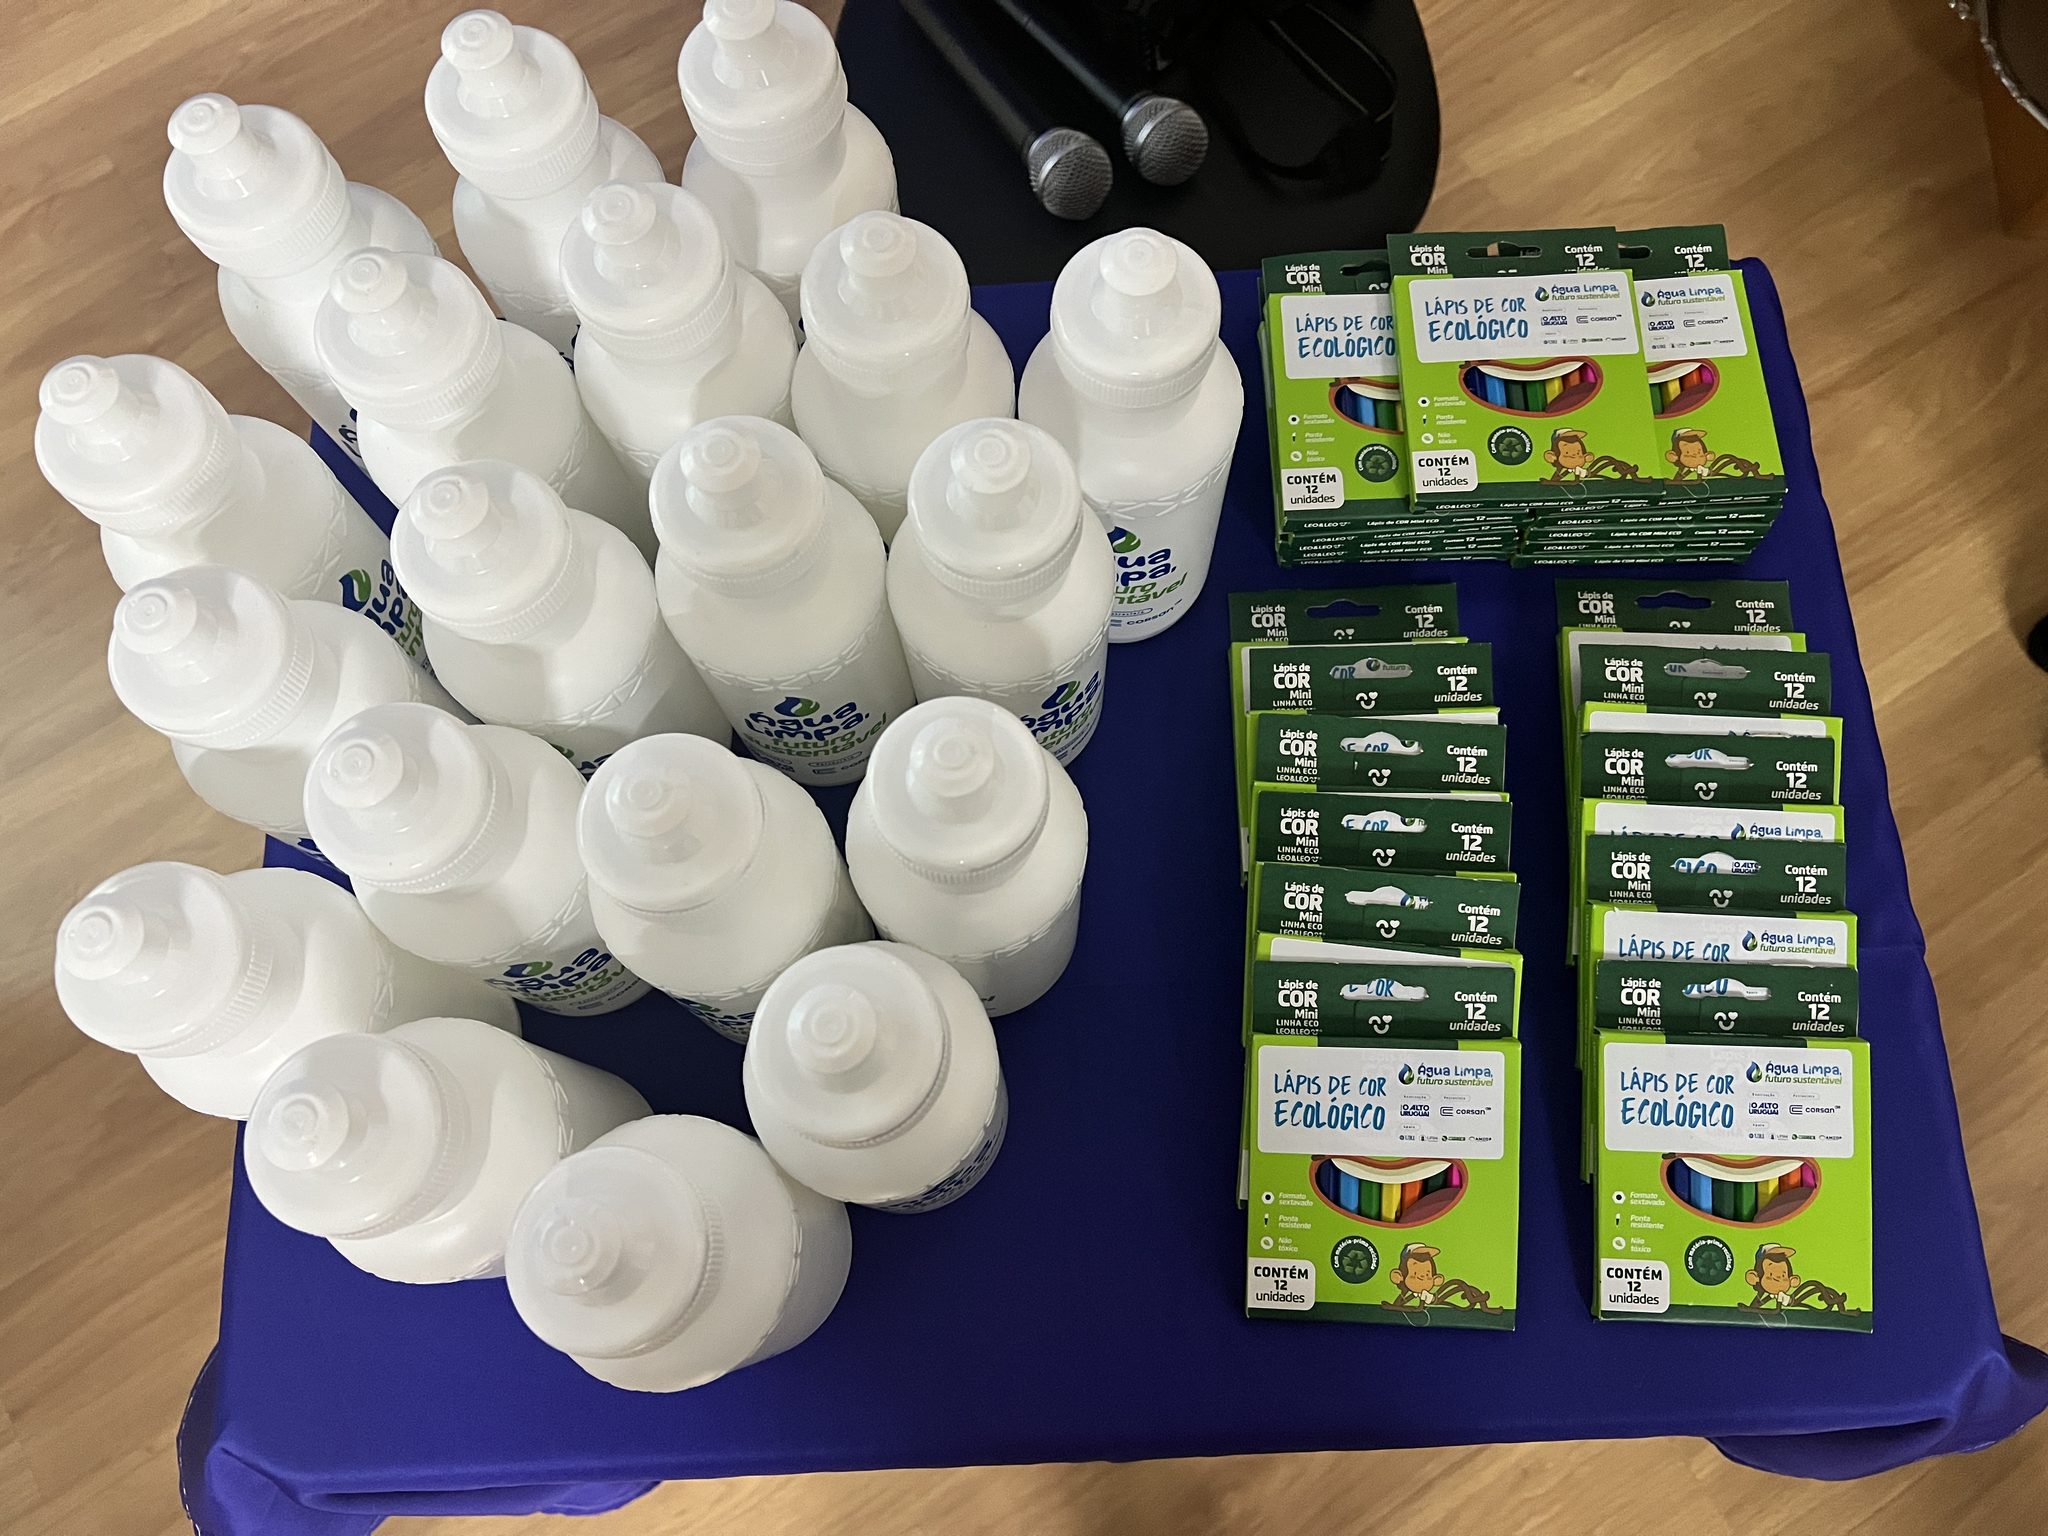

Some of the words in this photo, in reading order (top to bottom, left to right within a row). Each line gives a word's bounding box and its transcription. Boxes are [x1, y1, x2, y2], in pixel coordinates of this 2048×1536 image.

[1409, 245, 1432, 254] Lápis
[1434, 244, 1445, 252] de
[1564, 244, 1603, 254] Contém
[1674, 244, 1712, 255] Contém
[1411, 252, 1446, 267] COR
[1575, 254, 1595, 266] 12
[1685, 255, 1704, 268] 12
[1285, 264, 1307, 273] Lápis
[1427, 266, 1448, 274] Mini
[1286, 272, 1321, 285] COR
[1302, 285, 1322, 293] Mini
[1551, 284, 1580, 295] Água
[1425, 297, 1468, 317] LÁPIS
[1474, 298, 1493, 313] DE
[1501, 297, 1527, 313] COR
[1296, 313, 1338, 333] LÁPIS
[1343, 315, 1363, 332] DE
[1370, 315, 1394, 331] COR
[1428, 315, 1529, 342] ECOLÓGICO
[1298, 332, 1396, 359] ECOLÓGICO
[1418, 455, 1469, 468] CONTÉM
[1438, 467, 1451, 476] 12
[1286, 473, 1337, 485] CONTÉM
[1422, 477, 1469, 487] unidades
[1305, 485, 1319, 494] 12
[1290, 494, 1336, 505] unidades
[1117, 548, 1171, 568] ua
[1578, 592, 1600, 601] Lápis
[1602, 592, 1613, 600] de
[1251, 605, 1273, 614] Lápis
[1274, 604, 1286, 612] de
[1405, 605, 1442, 614] Contém
[1578, 600, 1614, 614] COR
[1735, 600, 1774, 609] Contém
[1251, 614, 1286, 628] COR
[1415, 615, 1435, 628] 12
[1595, 615, 1616, 624] Mini
[1746, 609, 1766, 623] 12
[1267, 628, 1287, 637] Mini
[1403, 628, 1448, 639] unidades
[1734, 623, 1781, 633] unidades
[1273, 663, 1297, 673] Lápis
[1299, 663, 1310, 672] de
[1604, 658, 1629, 667] Lápis
[1630, 659, 1643, 667] de
[1437, 665, 1477, 676] Contém
[1605, 667, 1643, 683] COR
[1273, 672, 1311, 689] COR
[1774, 671, 1816, 683] Contém
[1447, 676, 1468, 691] 12
[1621, 683, 1644, 693] Mini
[1290, 690, 1311, 700] Mini
[1434, 692, 1482, 702] unidades
[1784, 683, 1805, 699] 12
[1769, 699, 1819, 710] unidades
[749, 702, 857, 731] Água
[772, 731, 856, 749] futuro
[1280, 729, 1304, 739] Lápis
[1305, 730, 1318, 739] de
[1279, 740, 1317, 757] COR
[1447, 745, 1488, 756] Contém
[1294, 757, 1317, 767] Mini
[1456, 757, 1477, 773] 12
[1277, 766, 1301, 774] LINHA
[1303, 767, 1318, 775] ECO
[1441, 773, 1491, 785] unidades
[1750, 822, 1781, 838] Água
[1611, 852, 1636, 862] Lápis
[1638, 852, 1651, 861] de
[1611, 862, 1650, 880] COR
[1785, 864, 1828, 876] Contém
[1628, 880, 1651, 891] Mini
[1795, 876, 1817, 893] 12
[1610, 890, 1634, 898] LINHA
[1636, 891, 1652, 899] ECO
[1780, 893, 1832, 905] unidades
[1760, 930, 1792, 945] Água
[1619, 934, 1666, 959] LÁPIS
[1672, 941, 1695, 960] DE
[1702, 943, 1730, 962] COR
[1760, 944, 1786, 953] futuro
[1787, 945, 1836, 955] sustentável
[1278, 979, 1304, 991] Lápis
[1306, 980, 1319, 990] de
[1621, 977, 1648, 989] Lápis
[1650, 978, 1661, 988] de
[1278, 990, 1318, 1008] COR
[1454, 991, 1498, 1003] Contém
[1621, 988, 1660, 1006] COR
[1797, 991, 1842, 1003] Contém
[1295, 1009, 1318, 1020] Mini
[1464, 1003, 1486, 1020] 12
[1637, 1007, 1660, 1017] Mini
[1809, 1004, 1830, 1020] 12
[1449, 1021, 1501, 1032] unidades
[1618, 1017, 1643, 1025] LINHA
[1646, 1018, 1661, 1026] ECO
[1792, 1021, 1845, 1033] unidades
[1417, 1063, 1450, 1078] Água
[1765, 1061, 1798, 1076] Água
[1274, 1069, 1321, 1095] LÁPIS
[1328, 1075, 1351, 1095] DE
[1359, 1076, 1387, 1097] COR
[1417, 1077, 1442, 1086] futuro
[1443, 1078, 1494, 1087] sustentável
[1620, 1067, 1669, 1093] LÁPIS
[1675, 1073, 1698, 1093] DE
[1706, 1074, 1734, 1095] COR
[1765, 1075, 1791, 1084] futuro
[1793, 1076, 1842, 1085] sustentável
[1274, 1097, 1386, 1131] ECOLÓGICO
[1621, 1095, 1734, 1129] ECOLÓGICO
[1254, 1265, 1309, 1279] CONTÉM
[1606, 1266, 1662, 1281] CONTÉM
[1274, 1280, 1288, 1291] 12
[1627, 1281, 1642, 1292] 12
[1256, 1291, 1305, 1303] unidades
[1609, 1292, 1660, 1305] unidades
